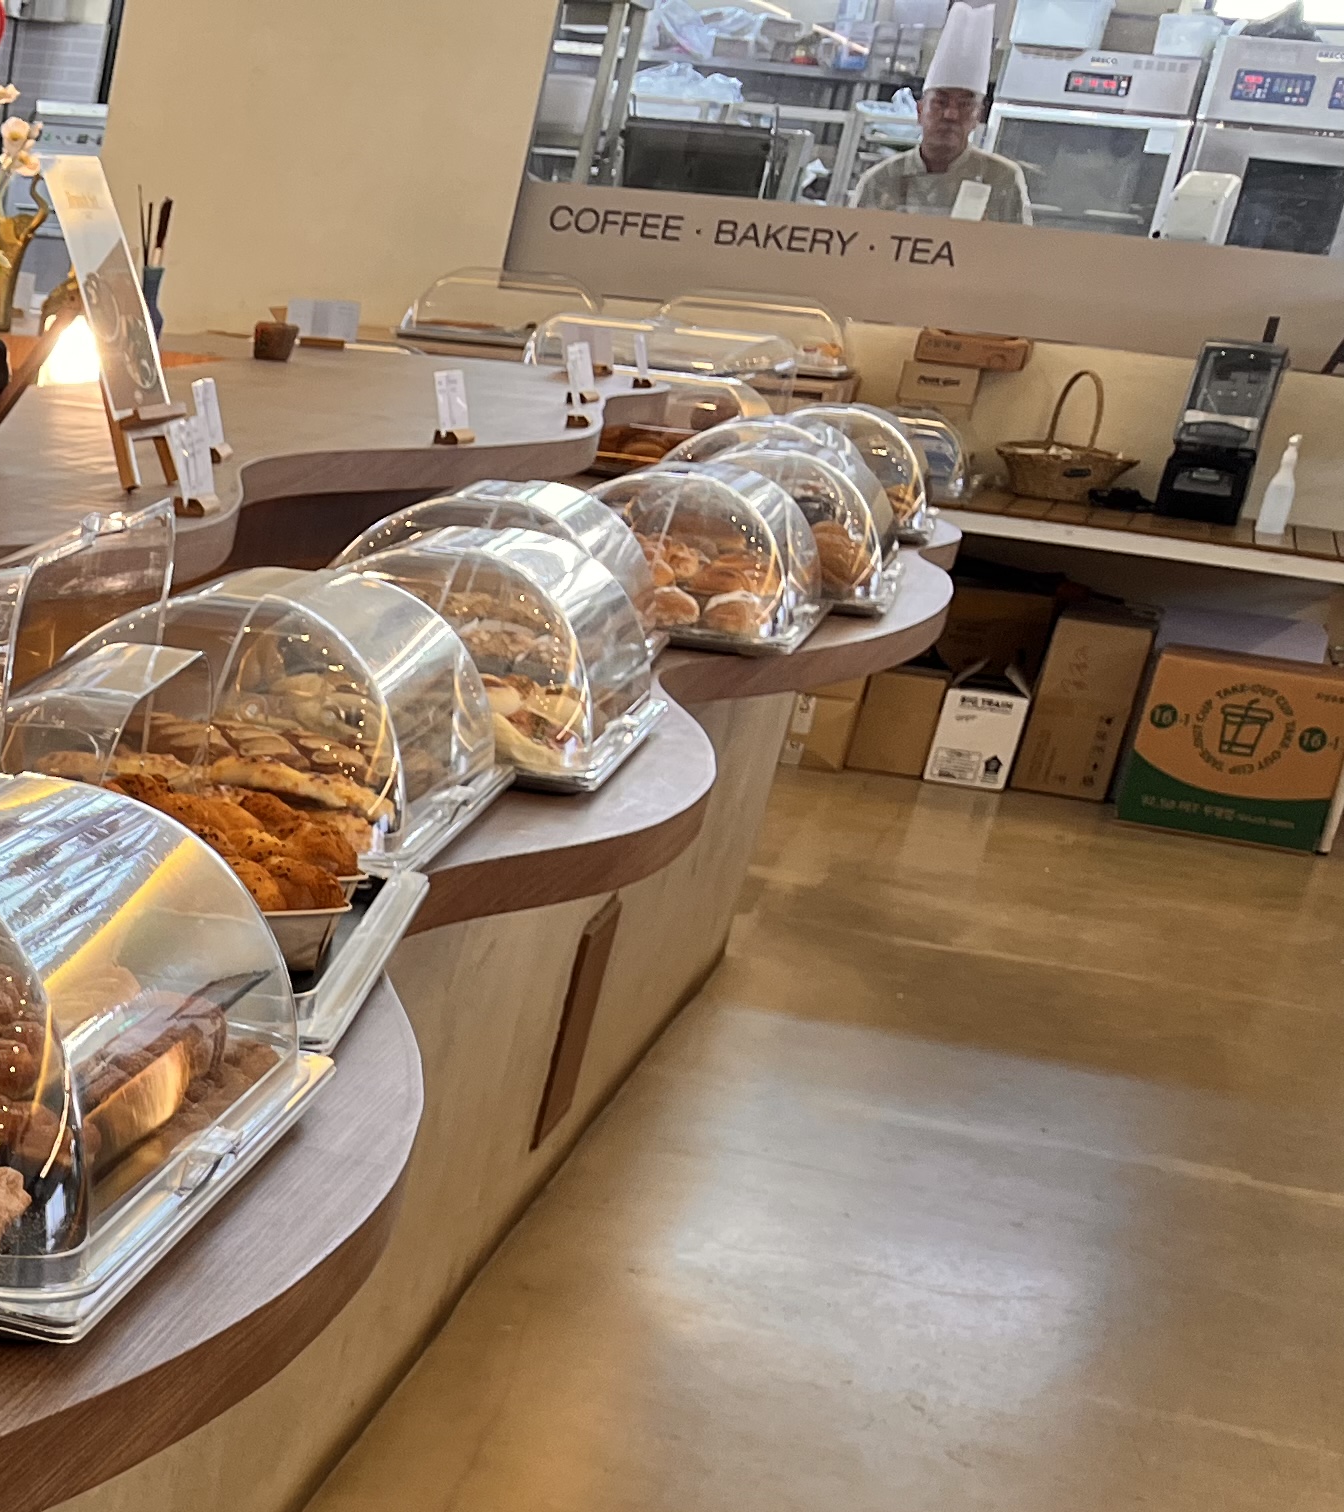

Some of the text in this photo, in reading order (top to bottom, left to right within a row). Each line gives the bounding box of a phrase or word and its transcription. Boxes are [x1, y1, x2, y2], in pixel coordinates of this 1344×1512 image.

[548, 204, 956, 267] COFFEE BAKERY TEA
